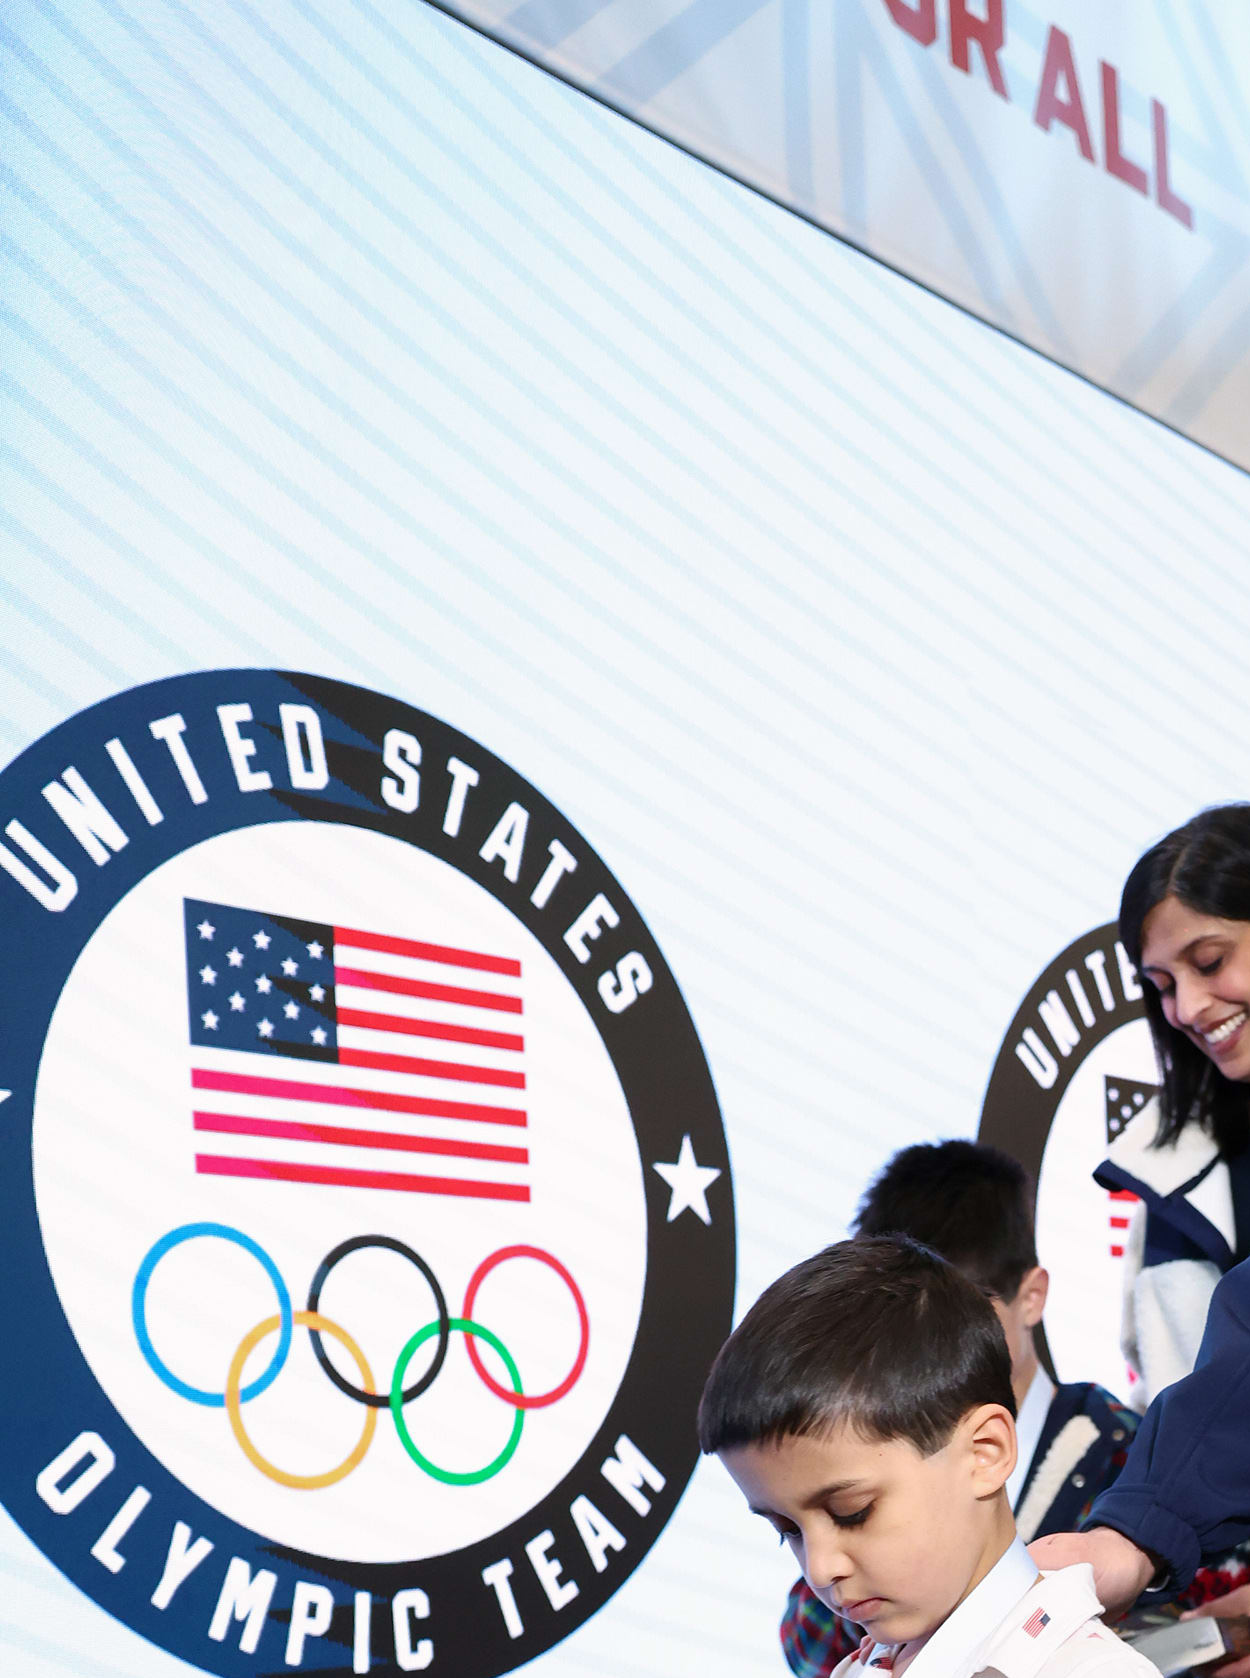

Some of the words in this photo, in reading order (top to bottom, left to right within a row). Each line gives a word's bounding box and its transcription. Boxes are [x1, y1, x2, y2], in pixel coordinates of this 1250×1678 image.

[1033, 23, 1194, 232] ALL
[0, 703, 329, 912] UNITED
[381, 728, 654, 1014] STATES
[1015, 941, 1144, 1089] UNITE
[36, 1431, 434, 1674] OLYMPIC
[483, 1434, 667, 1639] TEAM
